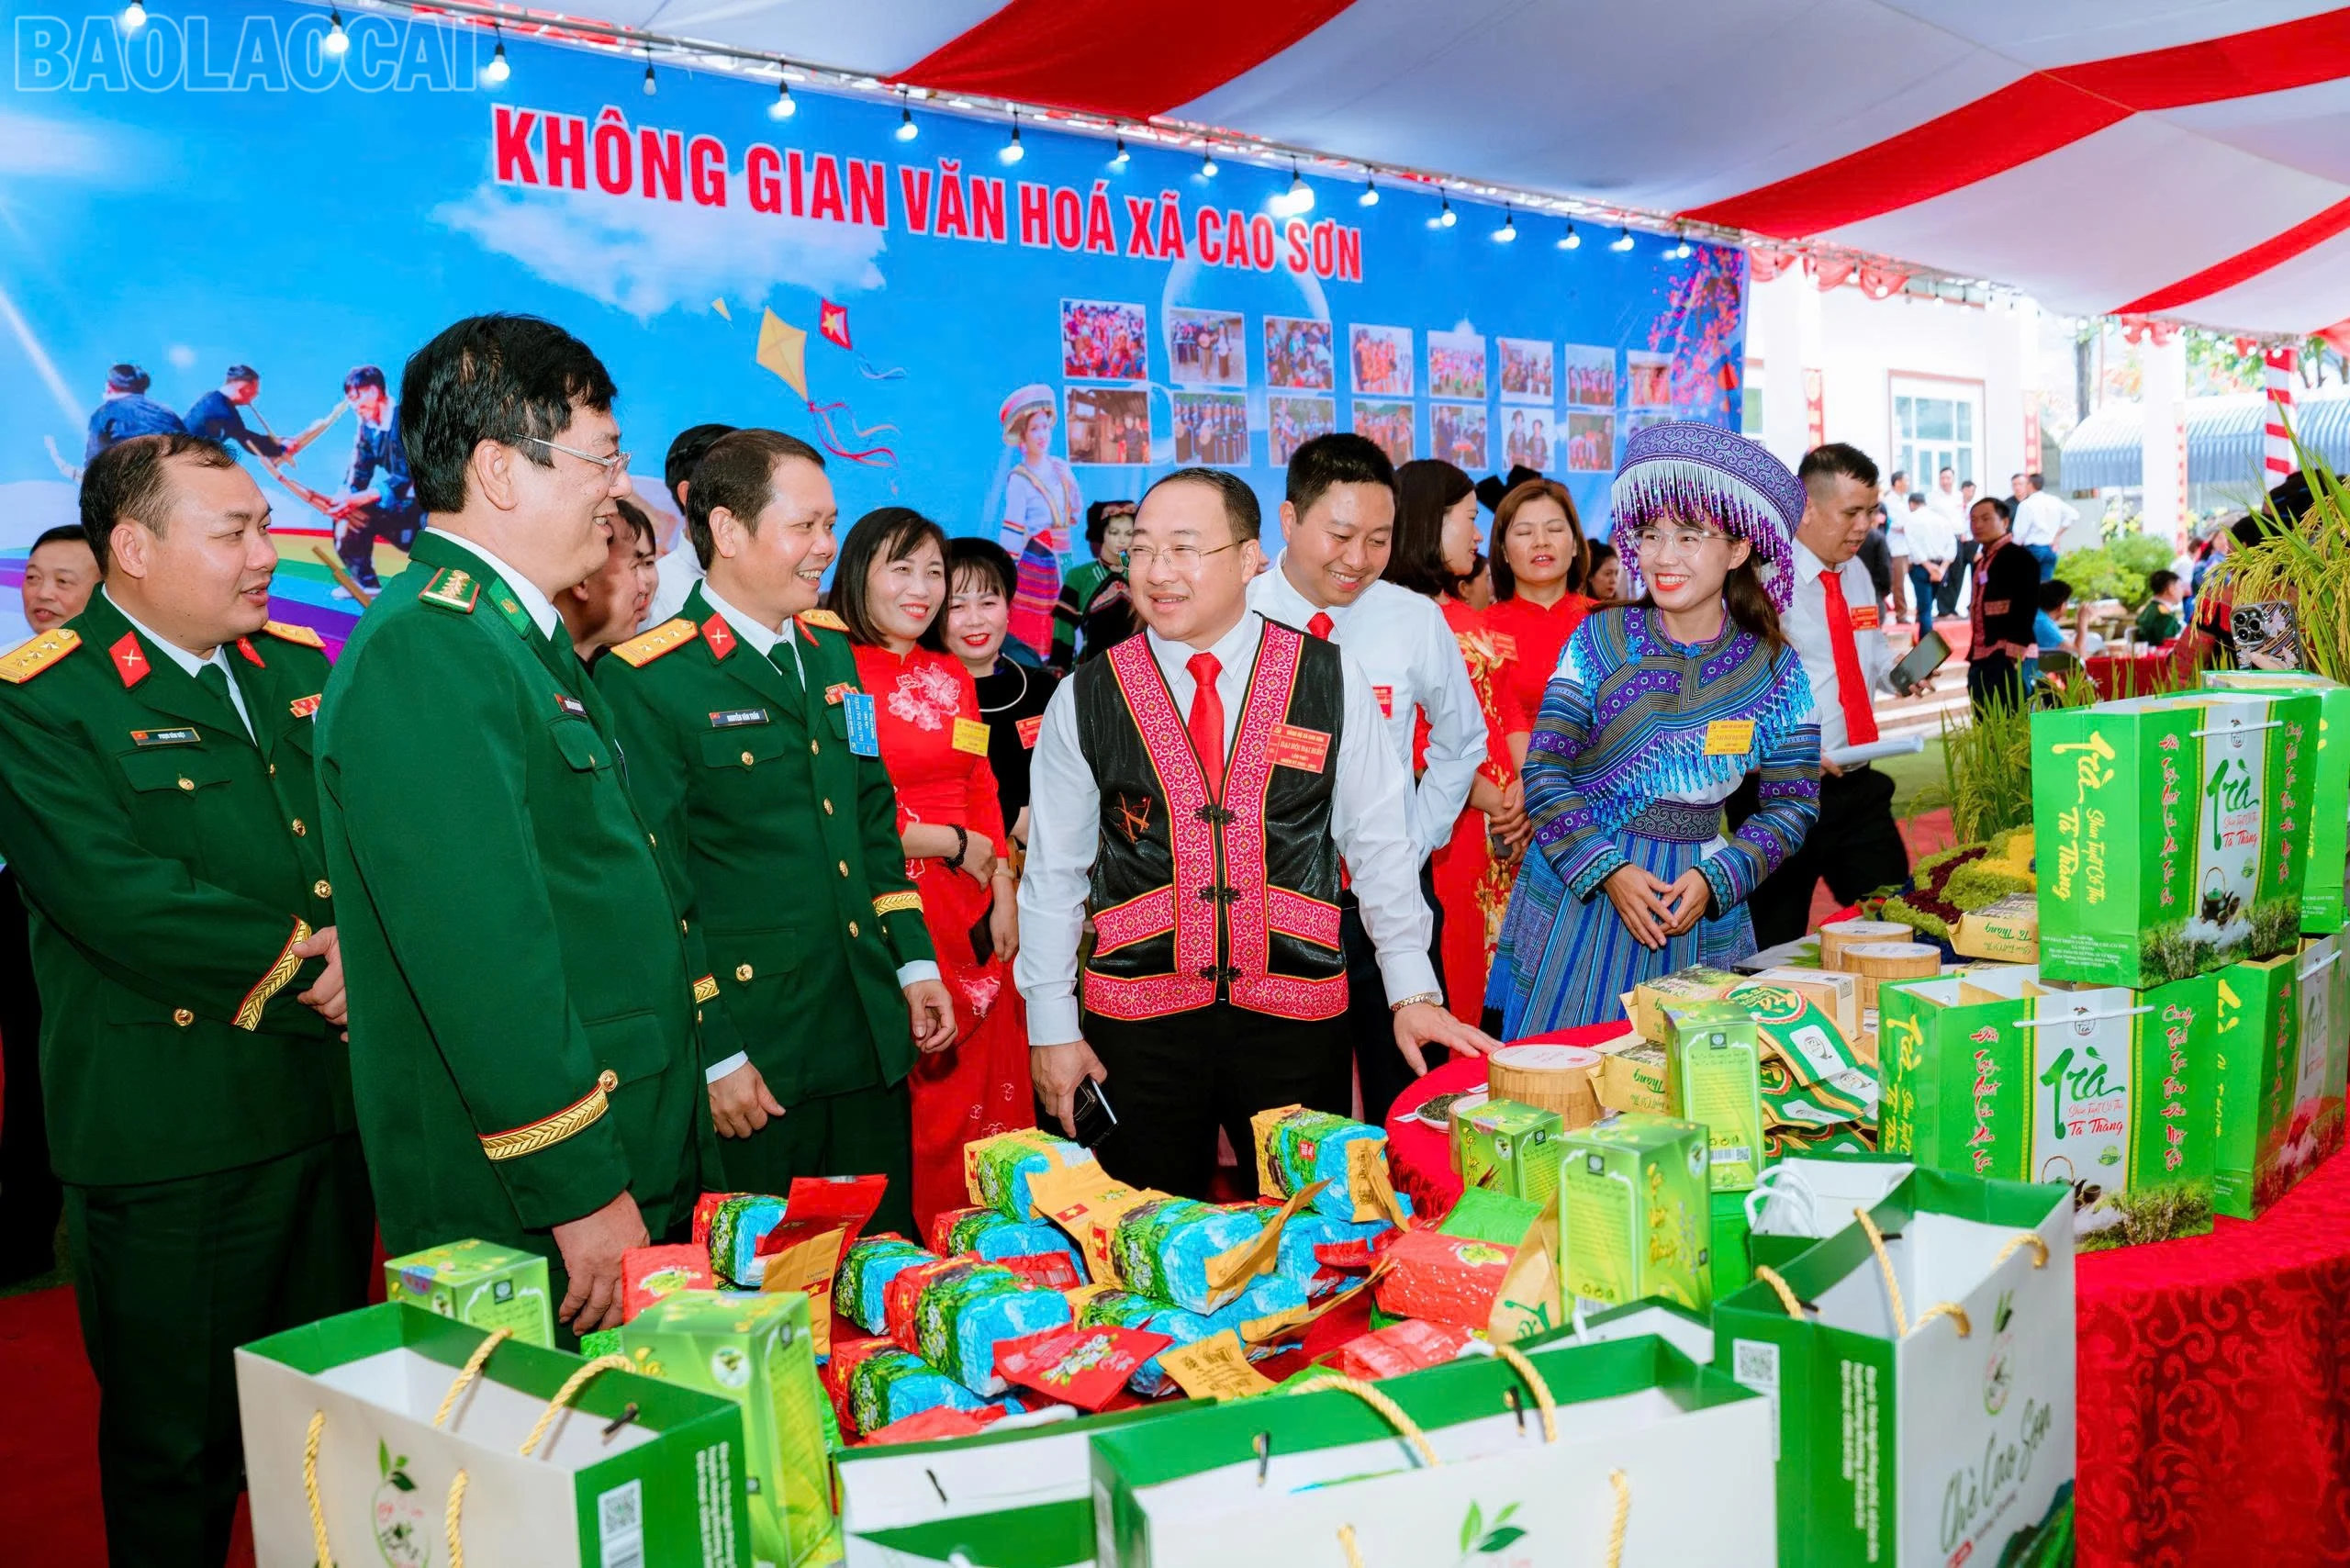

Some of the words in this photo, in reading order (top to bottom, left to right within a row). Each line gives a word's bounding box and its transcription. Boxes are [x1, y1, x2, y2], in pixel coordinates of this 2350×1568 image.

[494, 105, 728, 207] KHÔNG
[747, 143, 887, 230] GIAN
[900, 157, 1006, 242] VĂN
[1019, 181, 1117, 256] HOÁ
[1127, 189, 1186, 261] XÃ
[1196, 209, 1276, 274] CAO
[1287, 215, 1364, 283] SƠN
[2052, 731, 2115, 804] Trà
[2206, 758, 2260, 851] Trà
[1886, 1014, 1923, 1082] Trà
[2040, 1046, 2126, 1140] Trà
